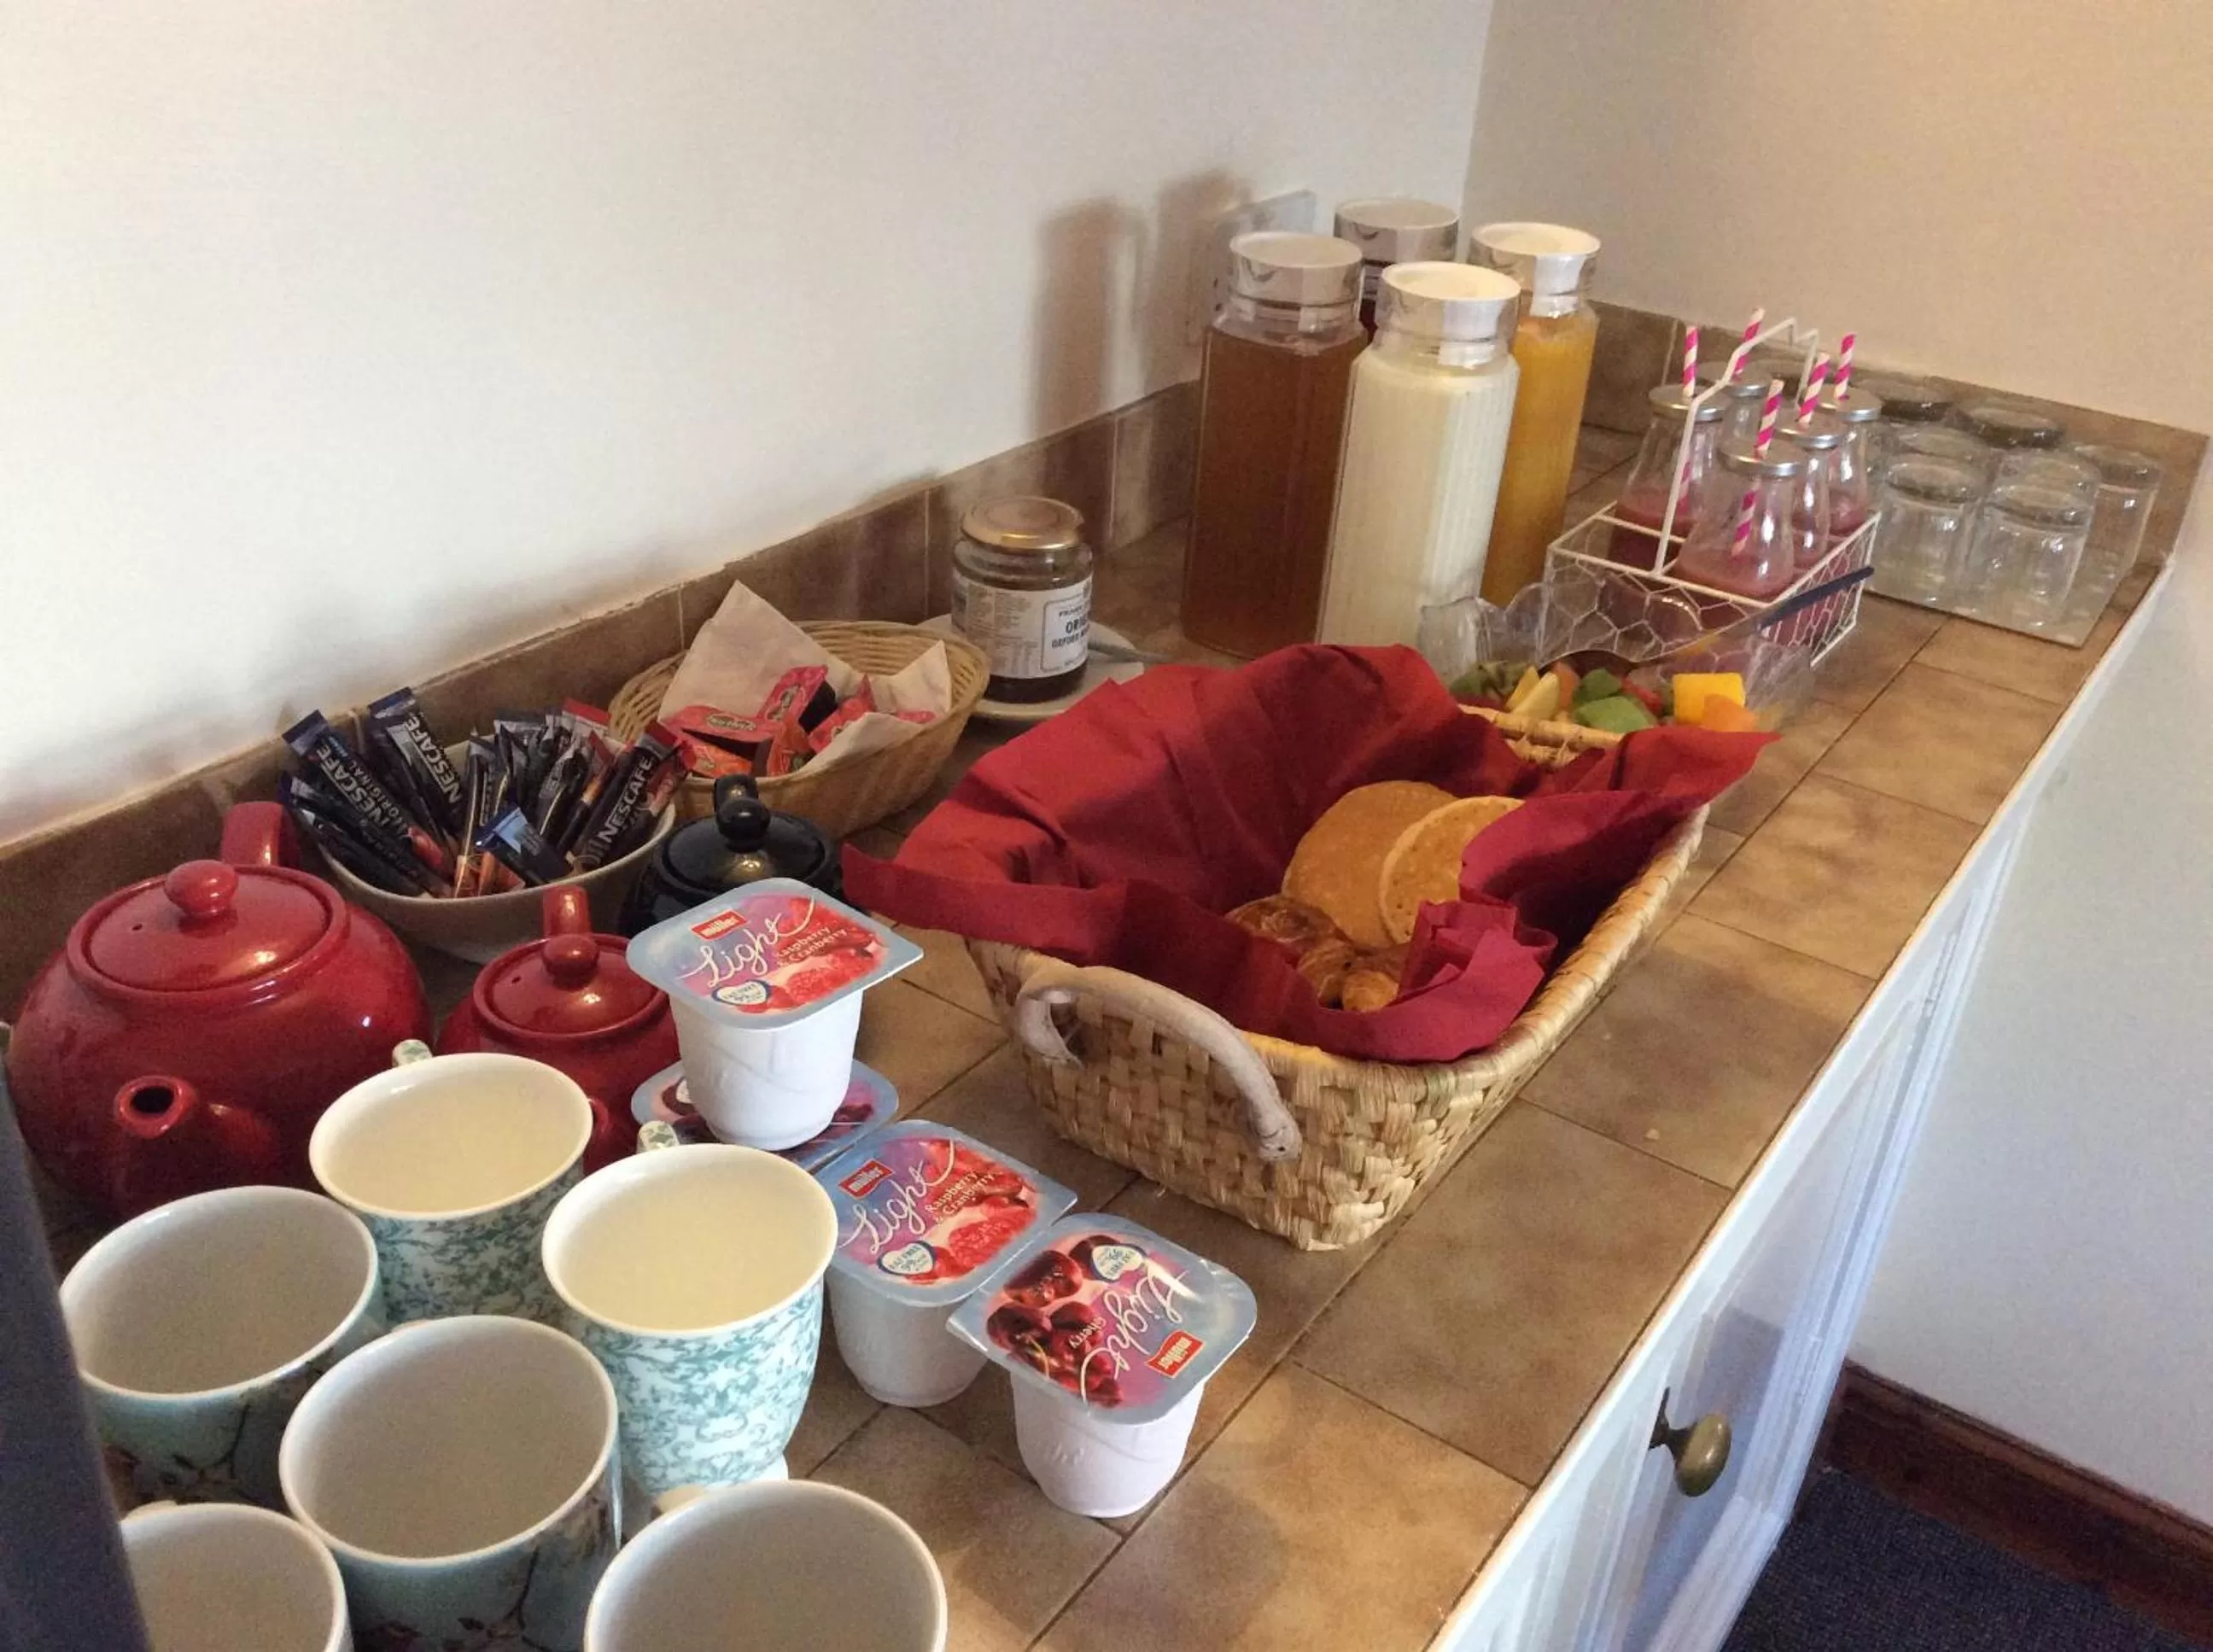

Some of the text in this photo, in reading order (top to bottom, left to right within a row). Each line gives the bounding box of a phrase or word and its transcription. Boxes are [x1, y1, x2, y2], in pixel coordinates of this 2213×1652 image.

[677, 896, 816, 988] Light
[838, 1140, 955, 1255] Light
[925, 1171, 979, 1212] Raspberry
[1068, 1316, 1107, 1349] Cherry
[1081, 1263, 1189, 1405] Light
